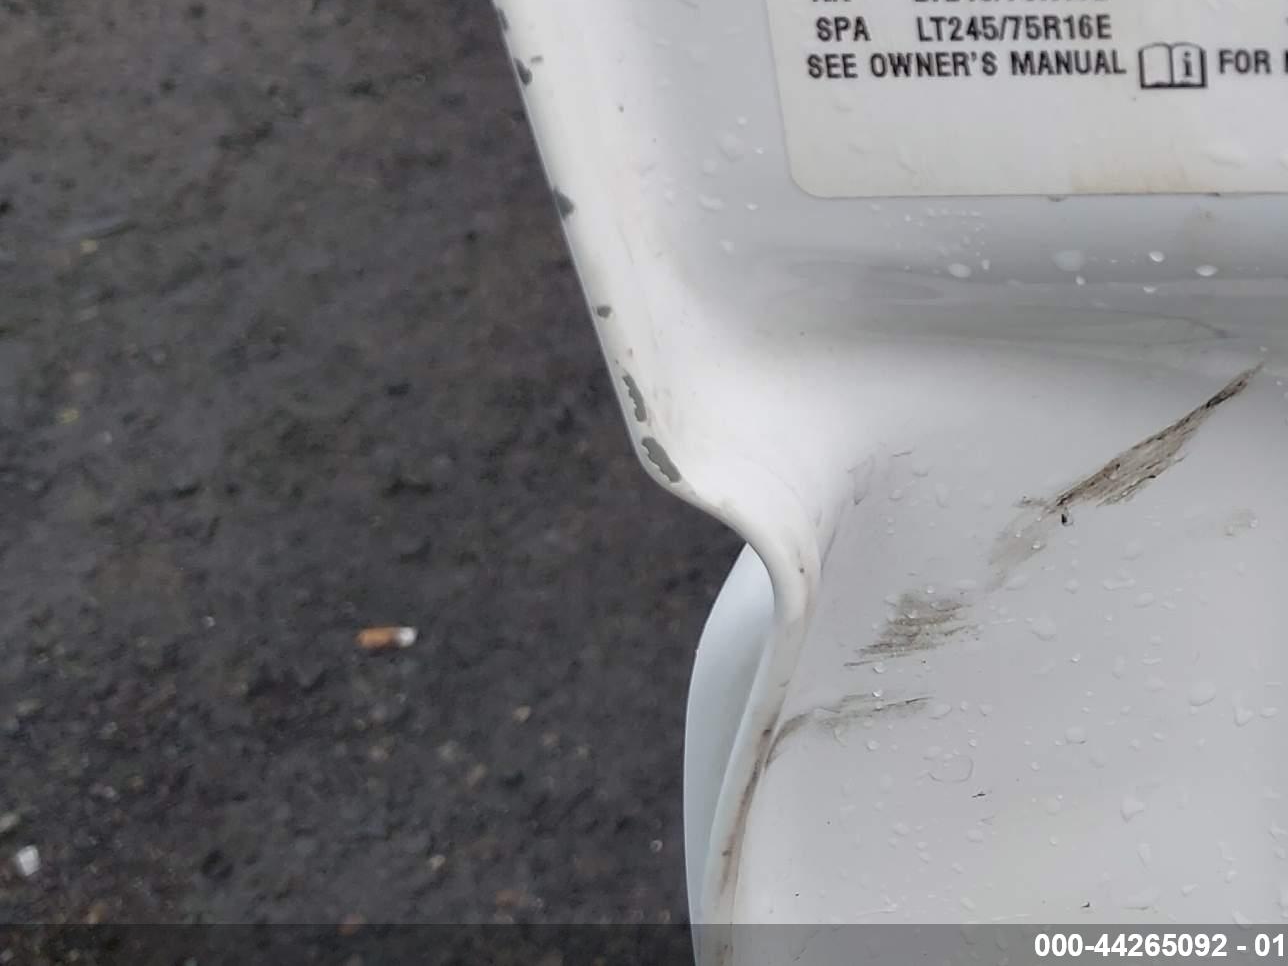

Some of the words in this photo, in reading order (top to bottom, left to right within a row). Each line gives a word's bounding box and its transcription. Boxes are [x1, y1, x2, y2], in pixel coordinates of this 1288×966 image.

[815, 17, 871, 44] SPA
[916, 15, 1112, 42] LT245/75R16E
[806, 53, 859, 80] SEE
[870, 51, 998, 78] OWNER'S
[1010, 50, 1127, 77] MANUAL
[1219, 50, 1271, 75] FOR
